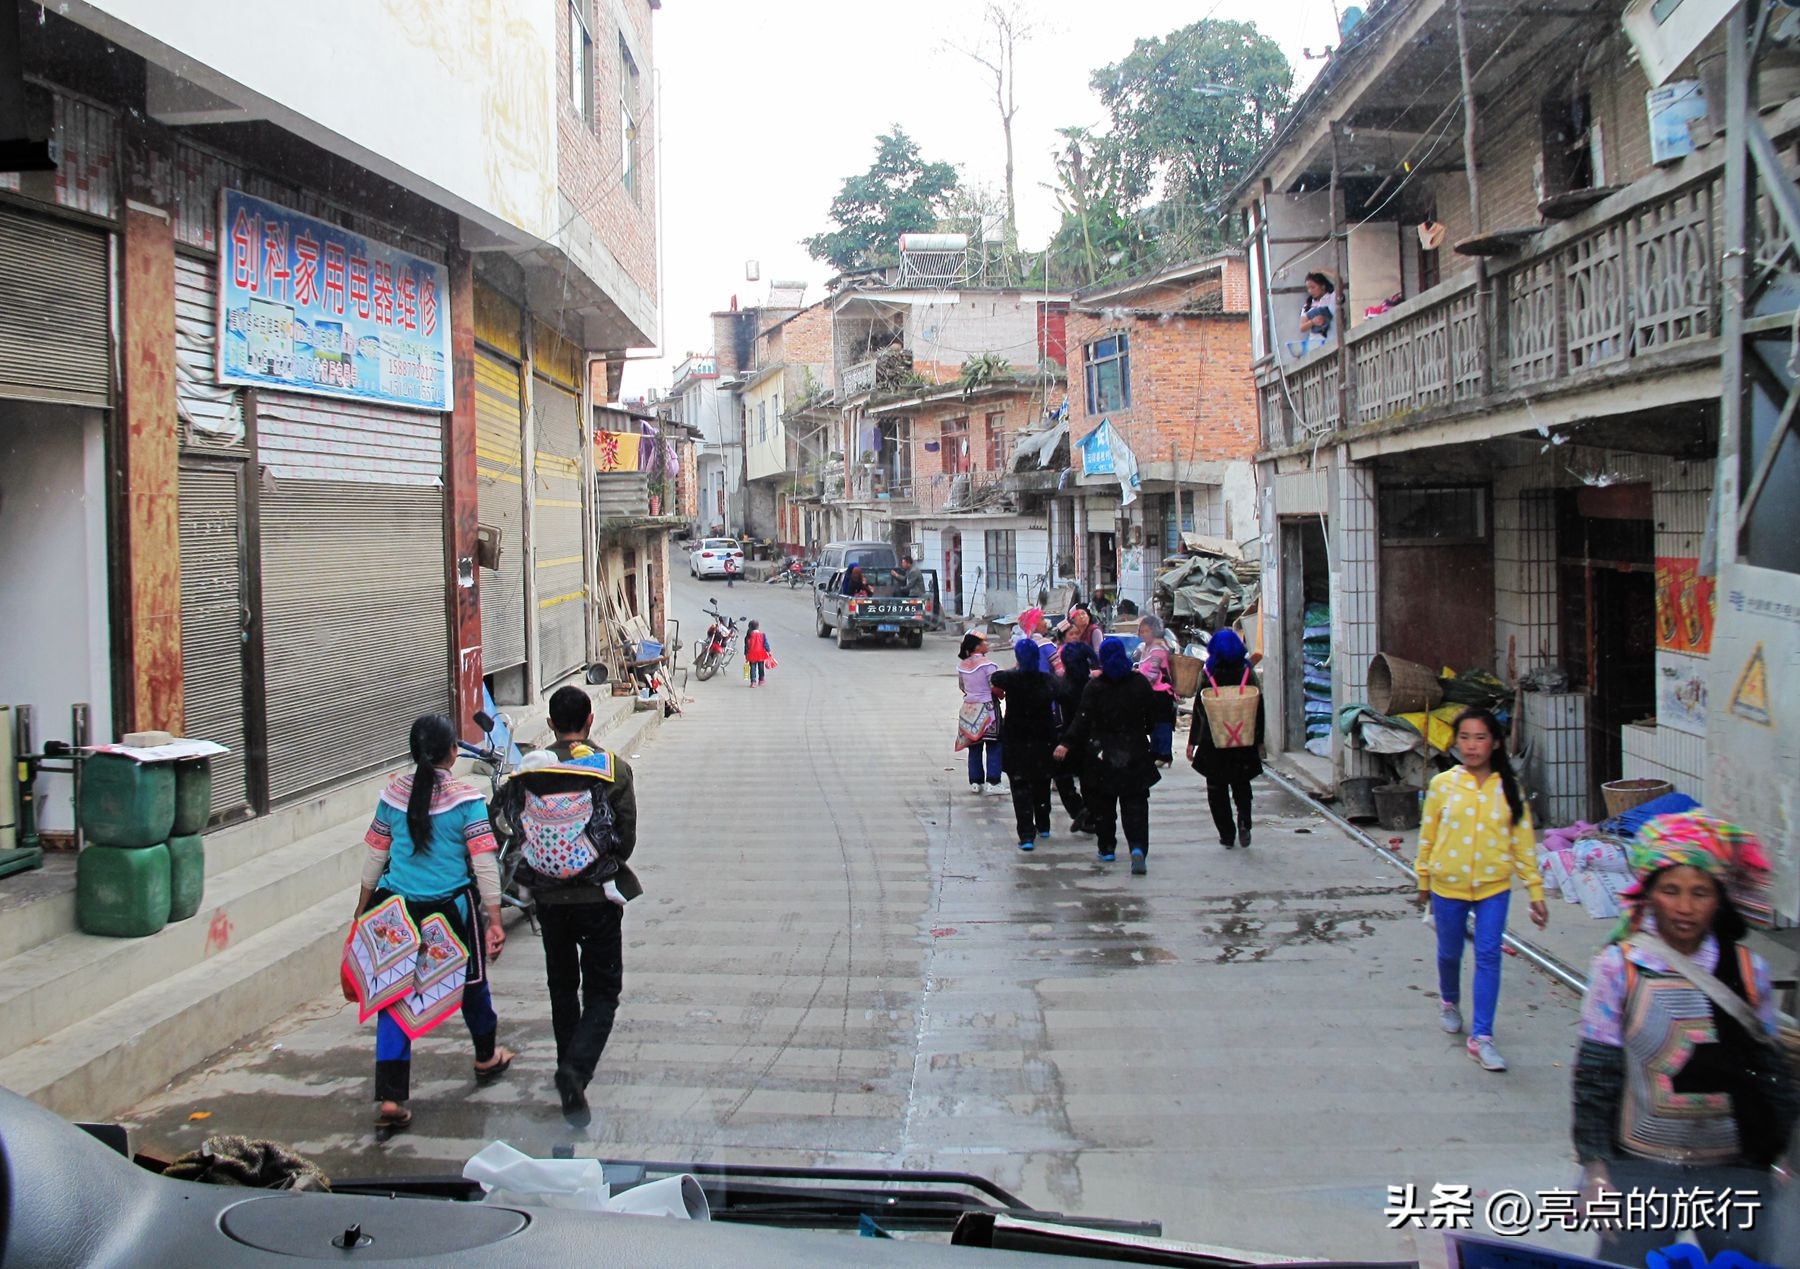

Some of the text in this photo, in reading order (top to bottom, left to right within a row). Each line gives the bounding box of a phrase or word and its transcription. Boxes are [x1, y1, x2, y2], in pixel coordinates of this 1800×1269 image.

[231, 206, 438, 337] 创科家用电器维修
[868, 605, 917, 613] 云G78745
